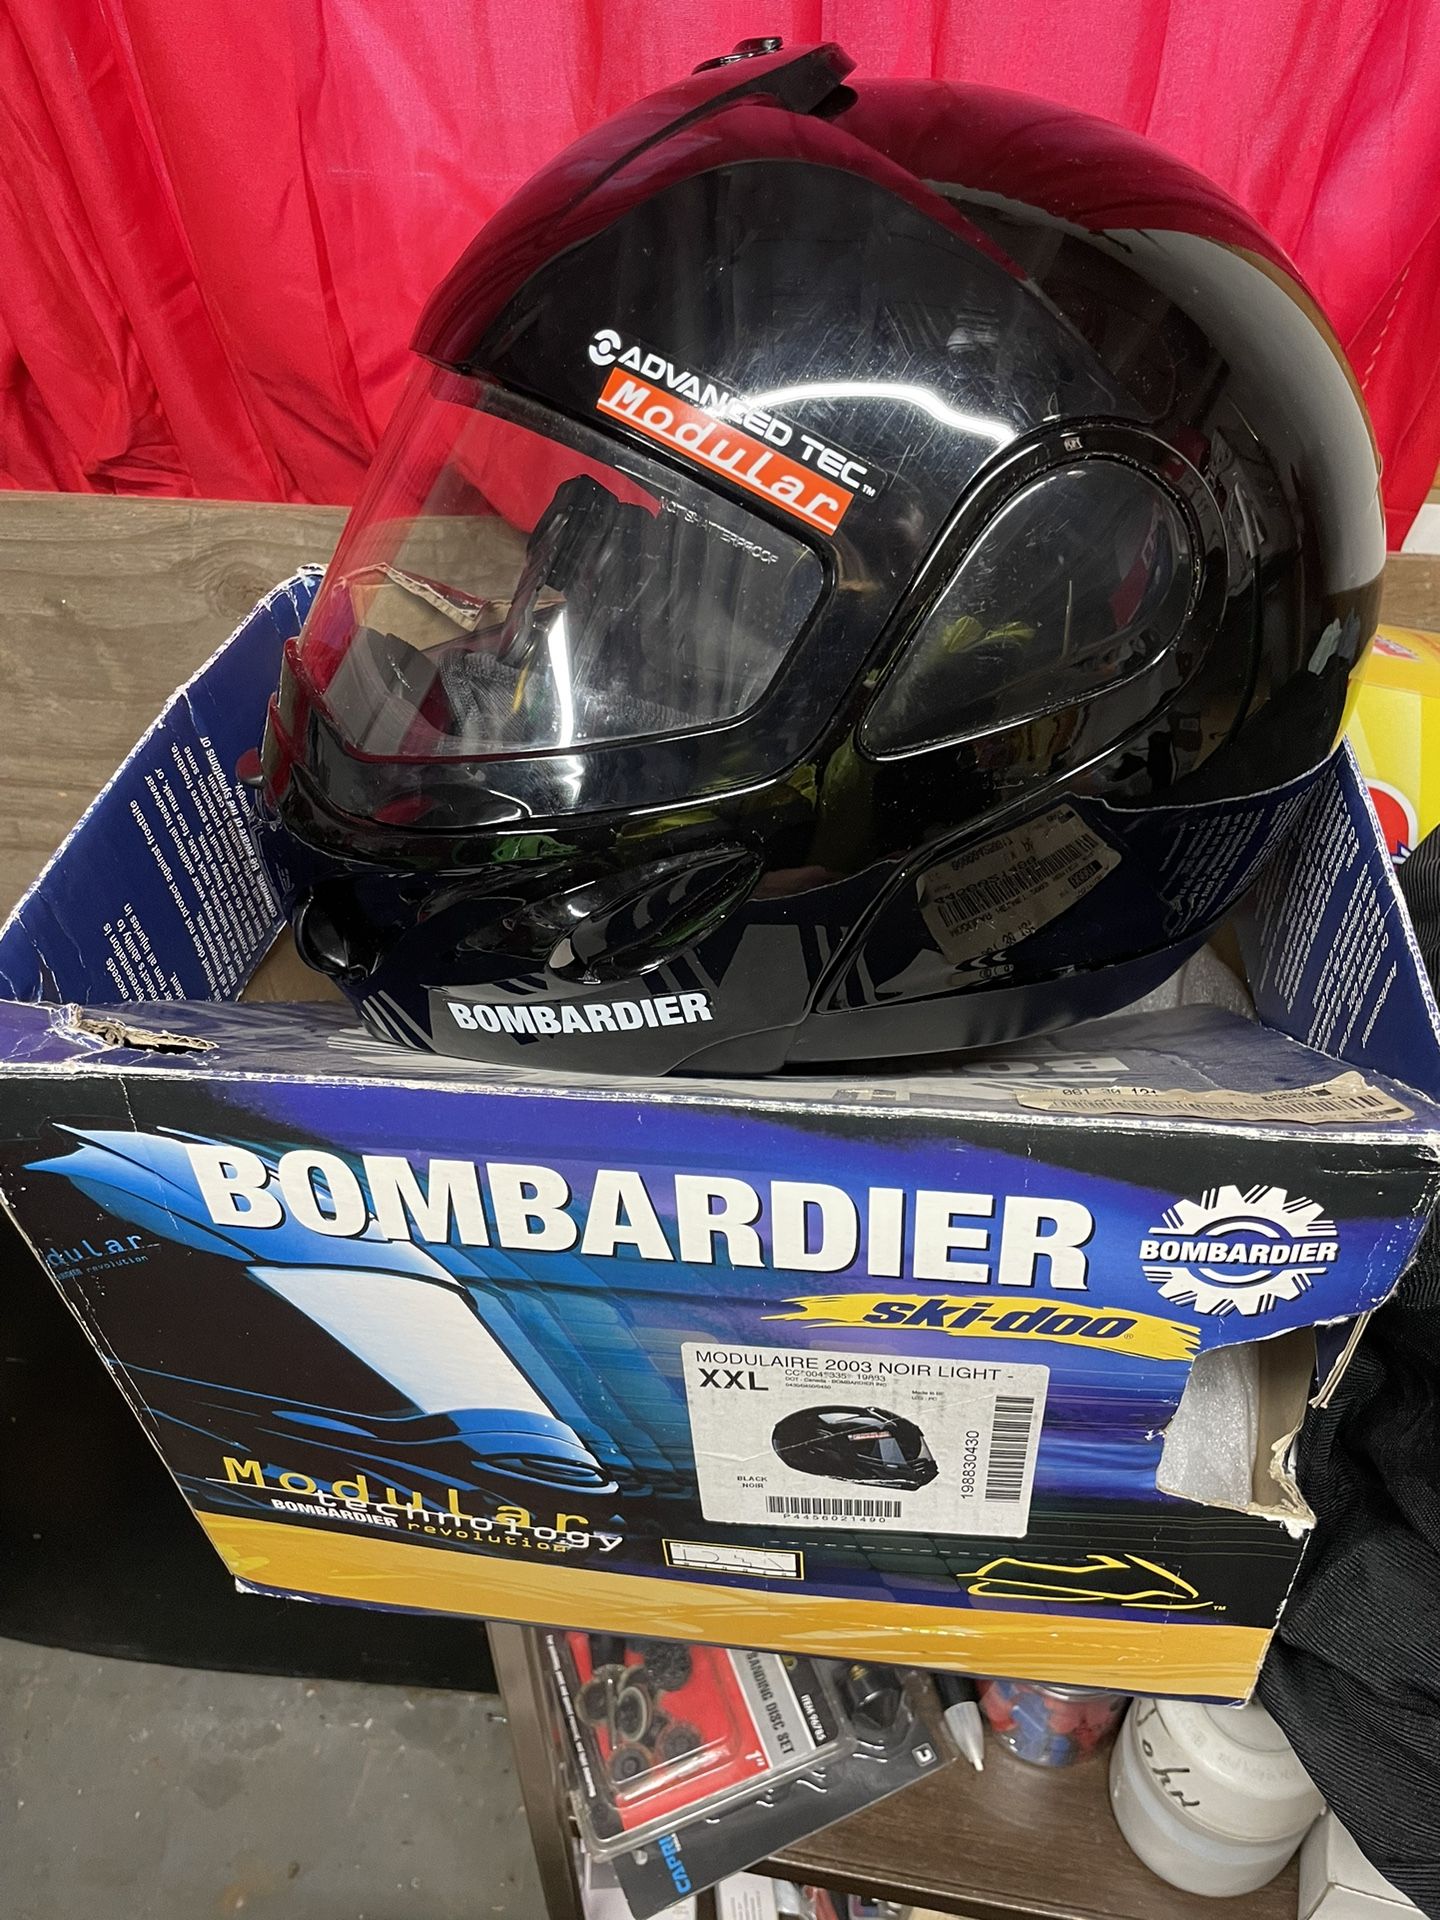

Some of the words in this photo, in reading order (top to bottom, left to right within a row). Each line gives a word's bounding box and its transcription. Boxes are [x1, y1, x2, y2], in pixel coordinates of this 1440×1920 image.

[605, 378, 840, 522] Modular
[800, 434, 867, 489] TEC
[144, 775, 173, 827] headwear
[130, 800, 155, 845] frostbite
[151, 844, 173, 882] against
[117, 919, 126, 932] to
[123, 931, 141, 962] ability
[130, 915, 151, 954] injuries
[106, 957, 129, 999] exceeds
[146, 952, 157, 966] all
[154, 965, 167, 991] from
[447, 992, 713, 1035] BOMBARDIER
[186, 1143, 1095, 1291] BOMBARDIER
[46, 1234, 142, 1267] dular
[1139, 1239, 1339, 1266] BOMBARDIER
[862, 1297, 1139, 1340] ski-doo
[695, 1350, 819, 1371] MODULAIRE
[825, 1359, 872, 1373] 2003
[879, 1362, 932, 1378] NOIR
[938, 1366, 1002, 1382] LIGHT
[698, 1368, 769, 1391] XXL
[737, 1475, 768, 1483] BLACK
[960, 1430, 980, 1499] 198830430
[222, 1456, 589, 1534] Modular
[270, 1498, 398, 1528] BOMBARDIER
[314, 1488, 623, 1552] technology
[407, 1522, 567, 1553] revolution
[764, 1702, 785, 1732] DISC
[775, 1732, 795, 1755] SET
[800, 1694, 814, 1718] ITEM
[809, 1712, 828, 1741] 96785
[657, 1834, 691, 1894] CAPRI
